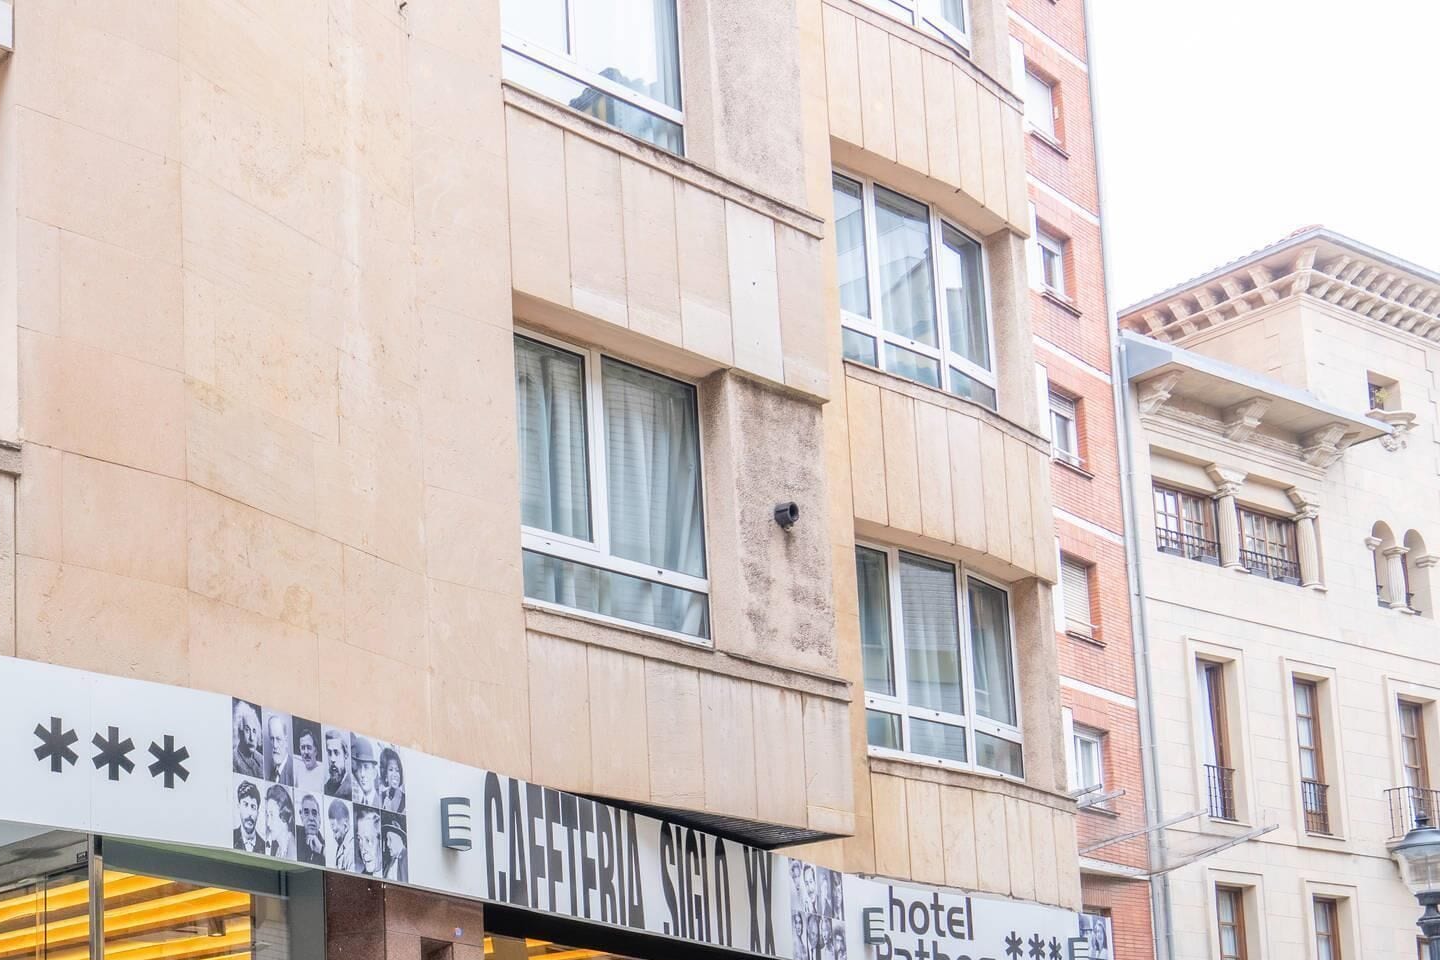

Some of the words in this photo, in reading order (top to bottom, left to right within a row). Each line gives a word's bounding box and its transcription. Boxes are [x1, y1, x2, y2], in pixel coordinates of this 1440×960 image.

[483, 770, 646, 931] CAFETERIA
[659, 820, 733, 949] SIGLO
[743, 845, 776, 958] XX
[888, 885, 975, 941] hotel
